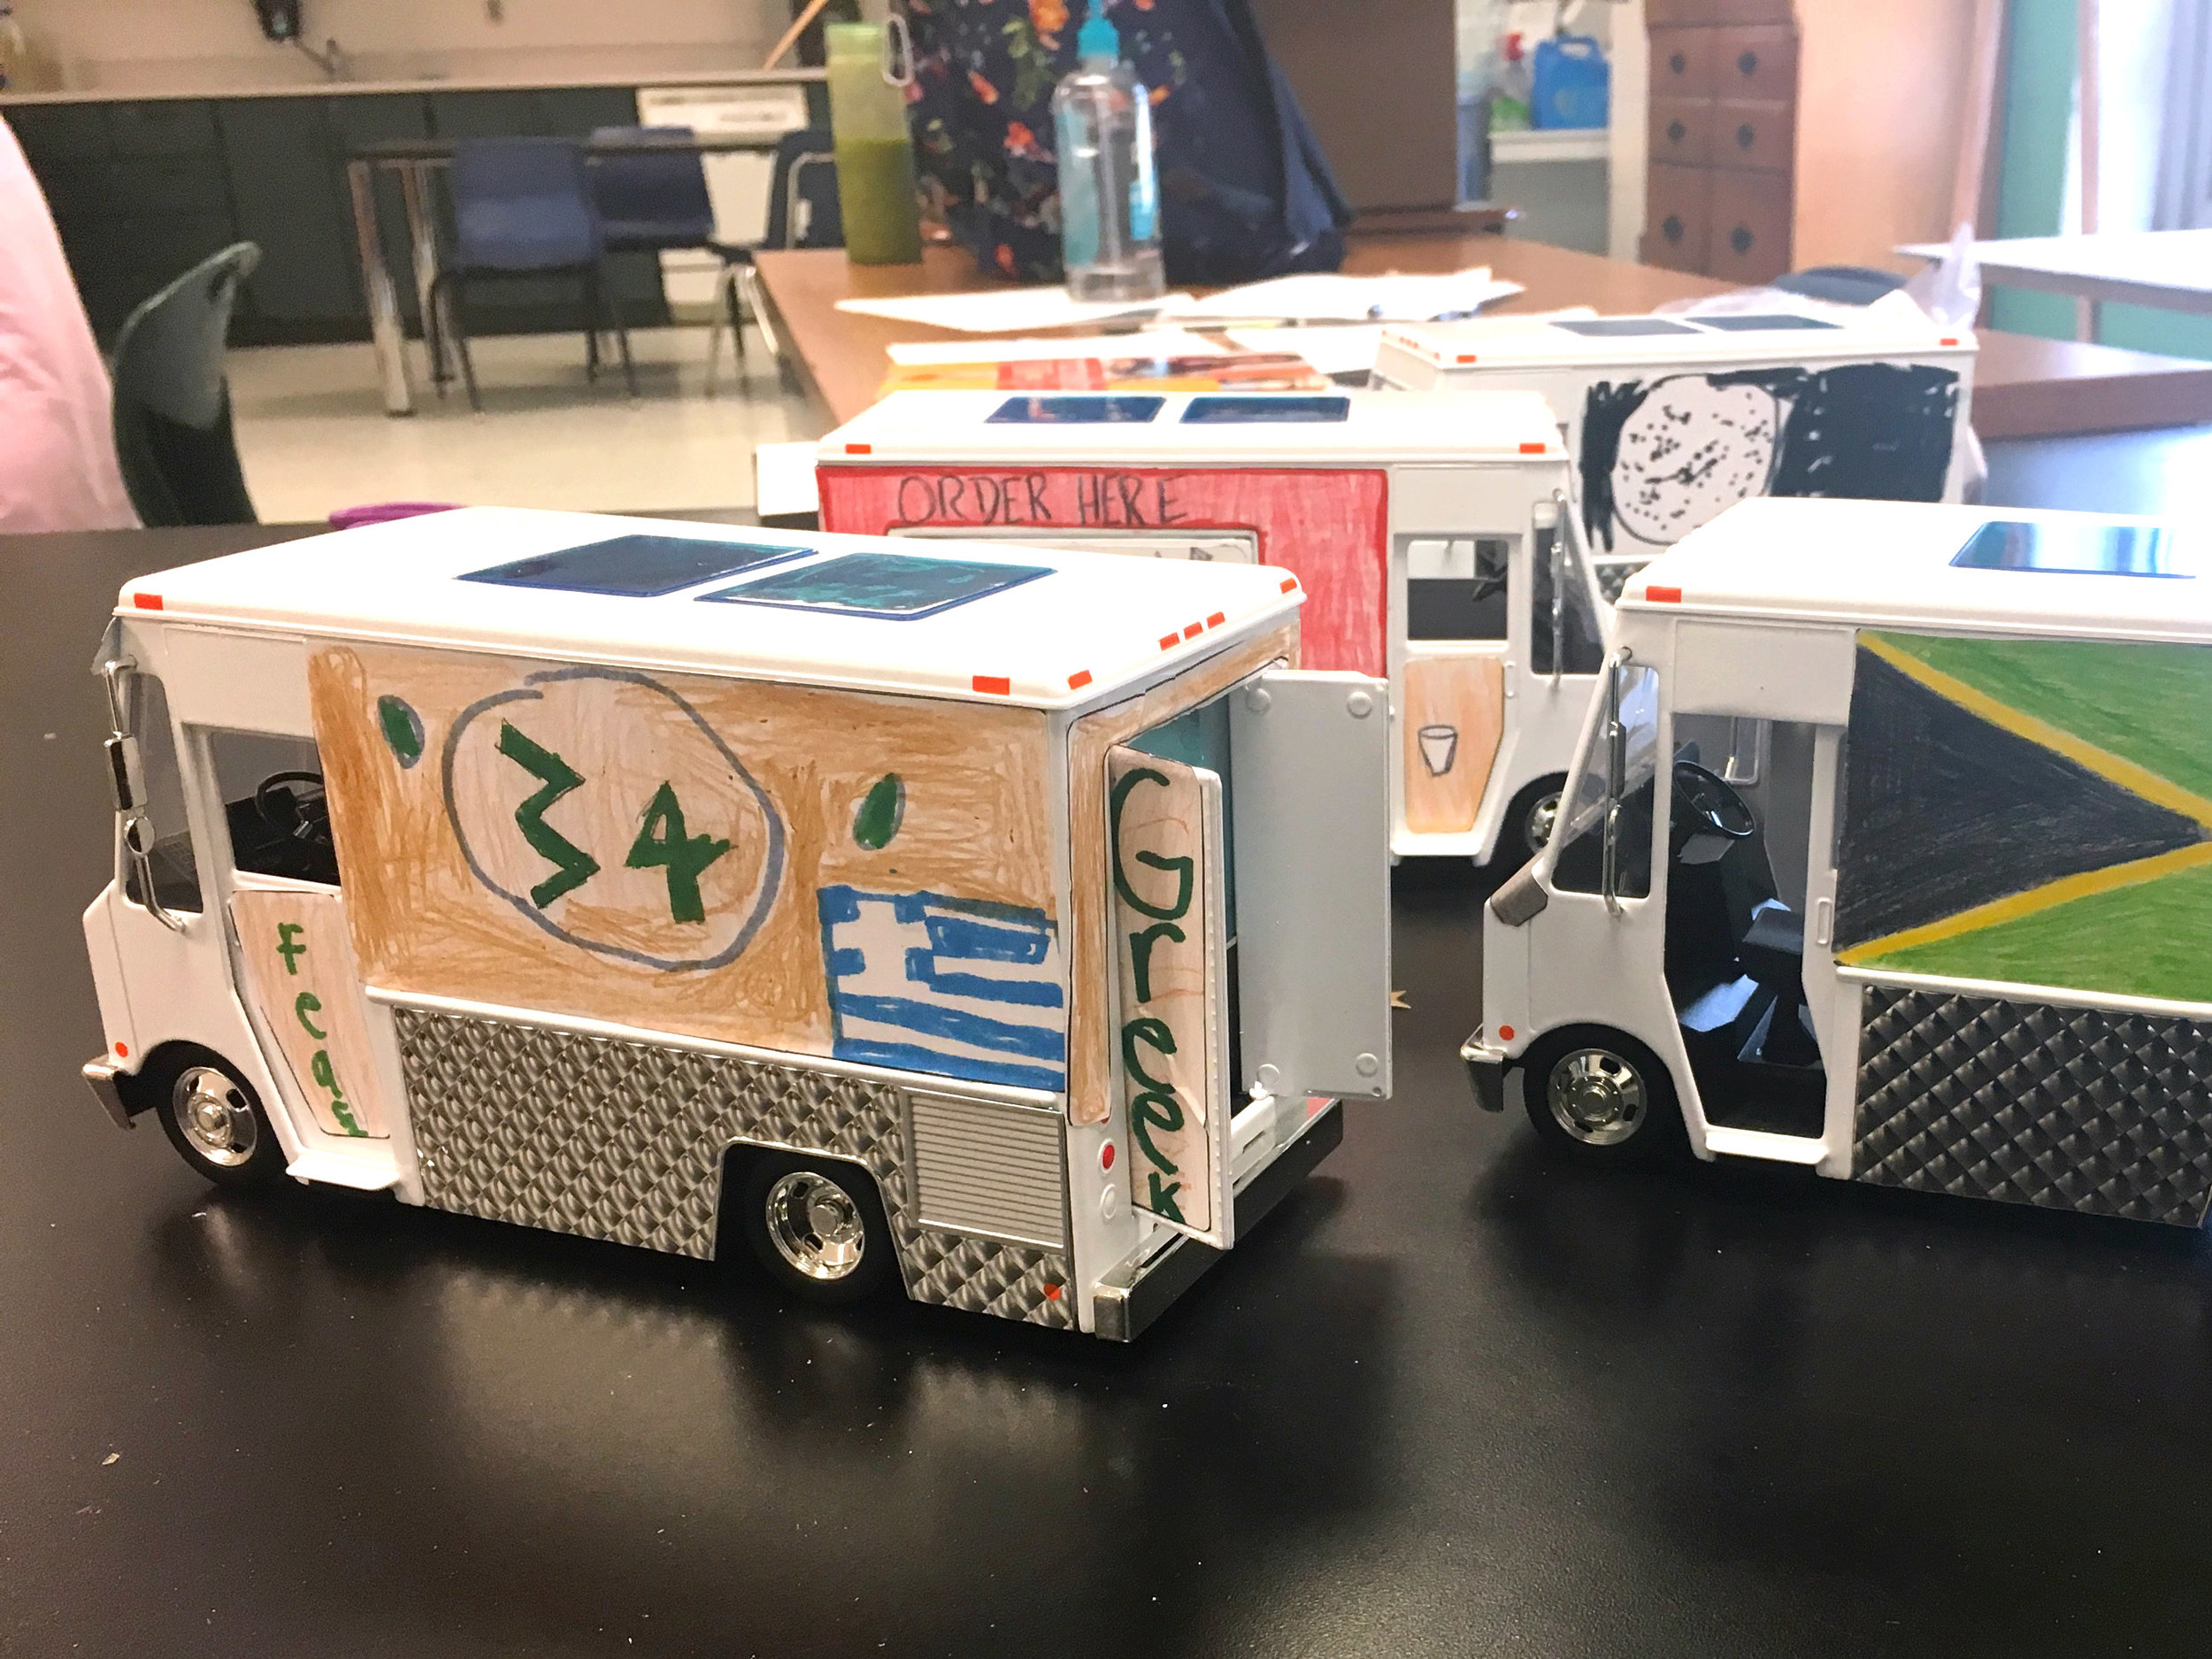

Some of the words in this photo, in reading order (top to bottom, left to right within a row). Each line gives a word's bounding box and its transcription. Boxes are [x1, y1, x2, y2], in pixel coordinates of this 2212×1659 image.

[897, 472, 1052, 526] ORDER
[1077, 472, 1187, 526] HERE
[1110, 766, 1194, 1225] Greek
